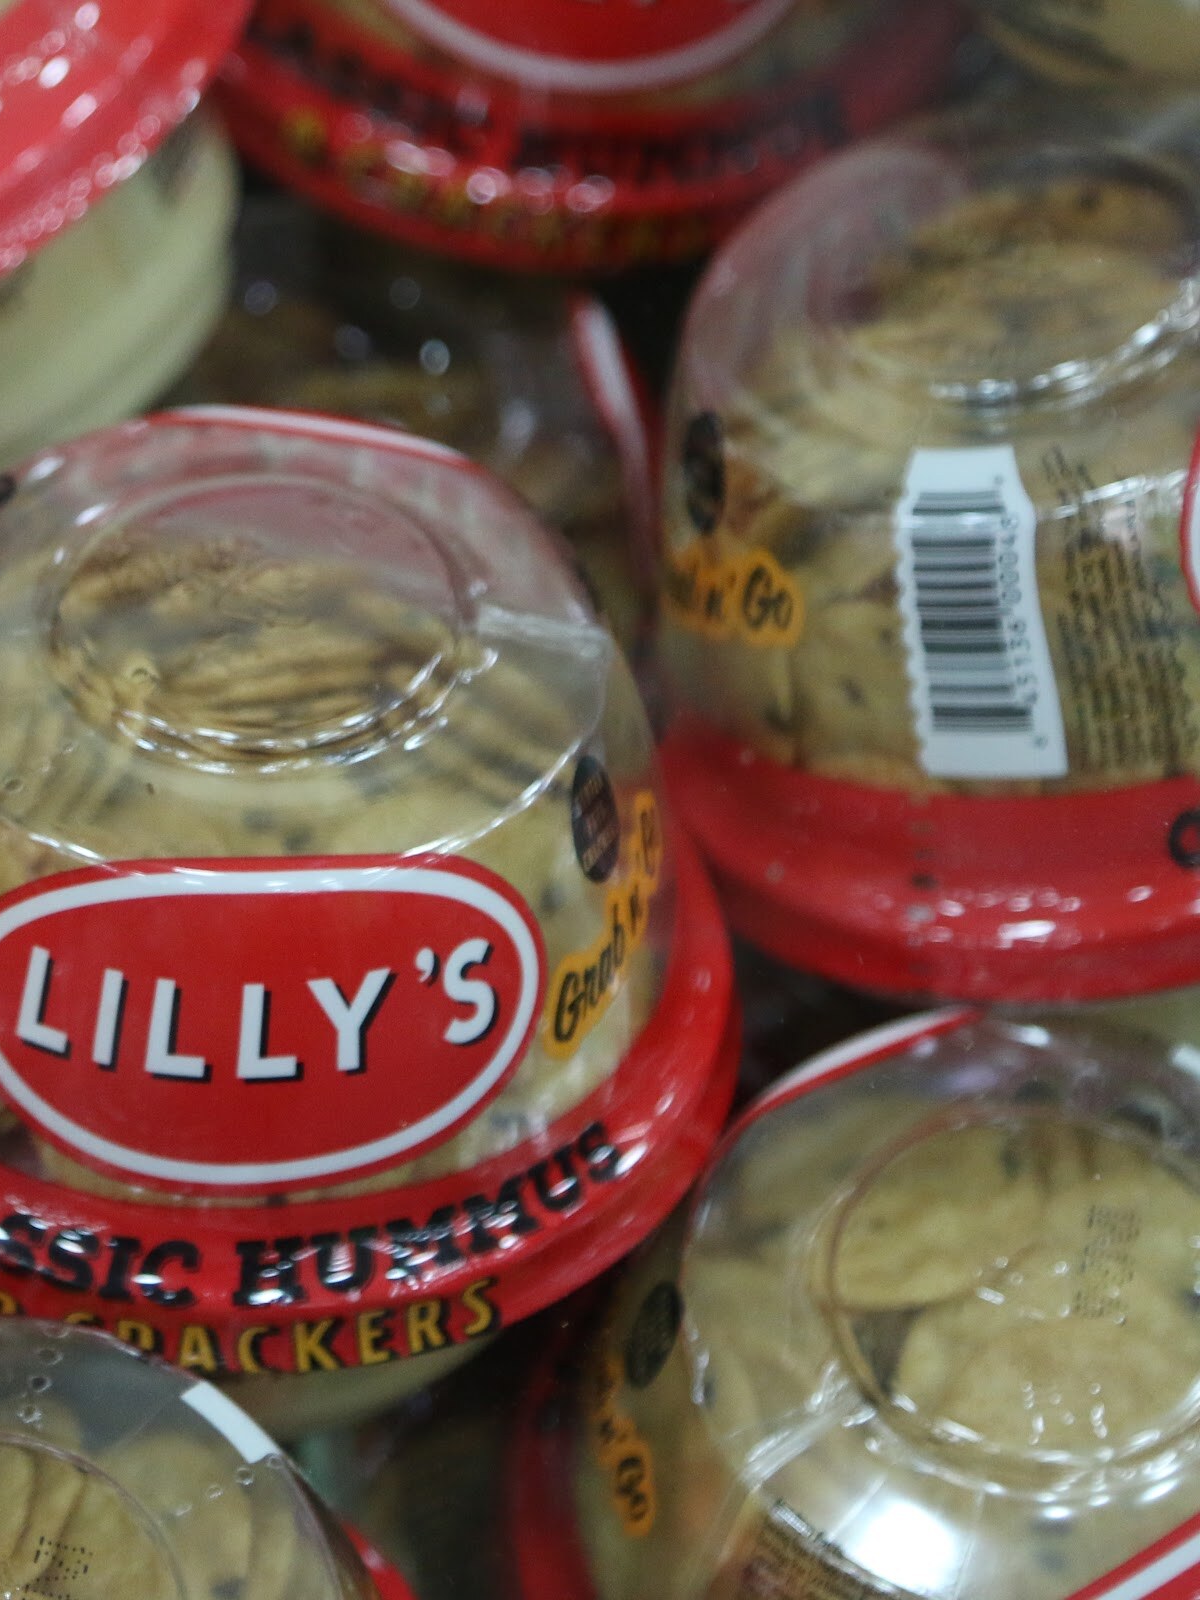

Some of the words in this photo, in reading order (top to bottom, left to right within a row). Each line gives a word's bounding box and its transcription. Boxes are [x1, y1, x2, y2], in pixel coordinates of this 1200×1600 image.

[743, 564, 794, 632] Go
[15, 936, 498, 1084] LILLY'S
[233, 1123, 622, 1307] HUMMUS
[66, 1277, 499, 1374] RACKERS
